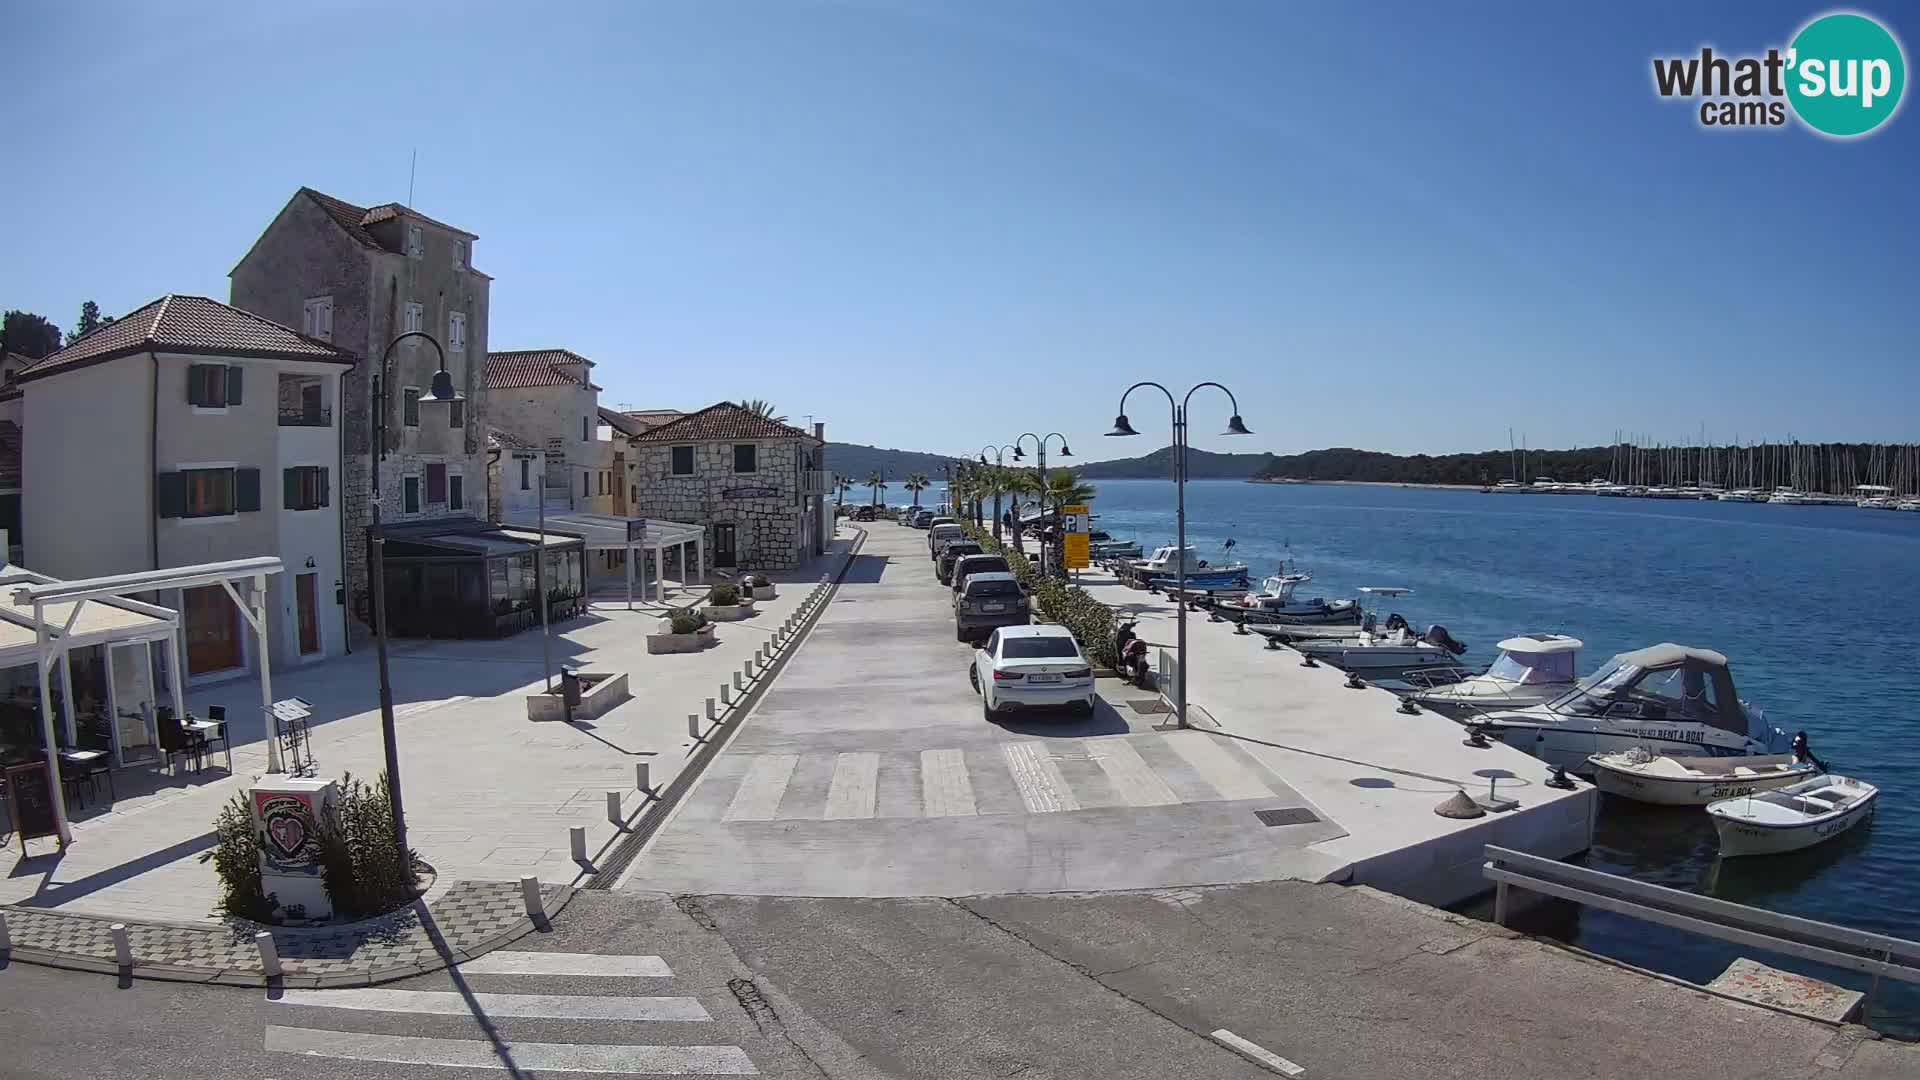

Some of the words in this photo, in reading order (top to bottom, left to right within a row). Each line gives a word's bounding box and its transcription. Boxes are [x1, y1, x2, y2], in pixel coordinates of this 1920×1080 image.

[1066, 515, 1076, 531] P
[1658, 729, 1678, 740] RENT
[1686, 730, 1705, 743] BOAT
[1737, 786, 1755, 797] BOA
